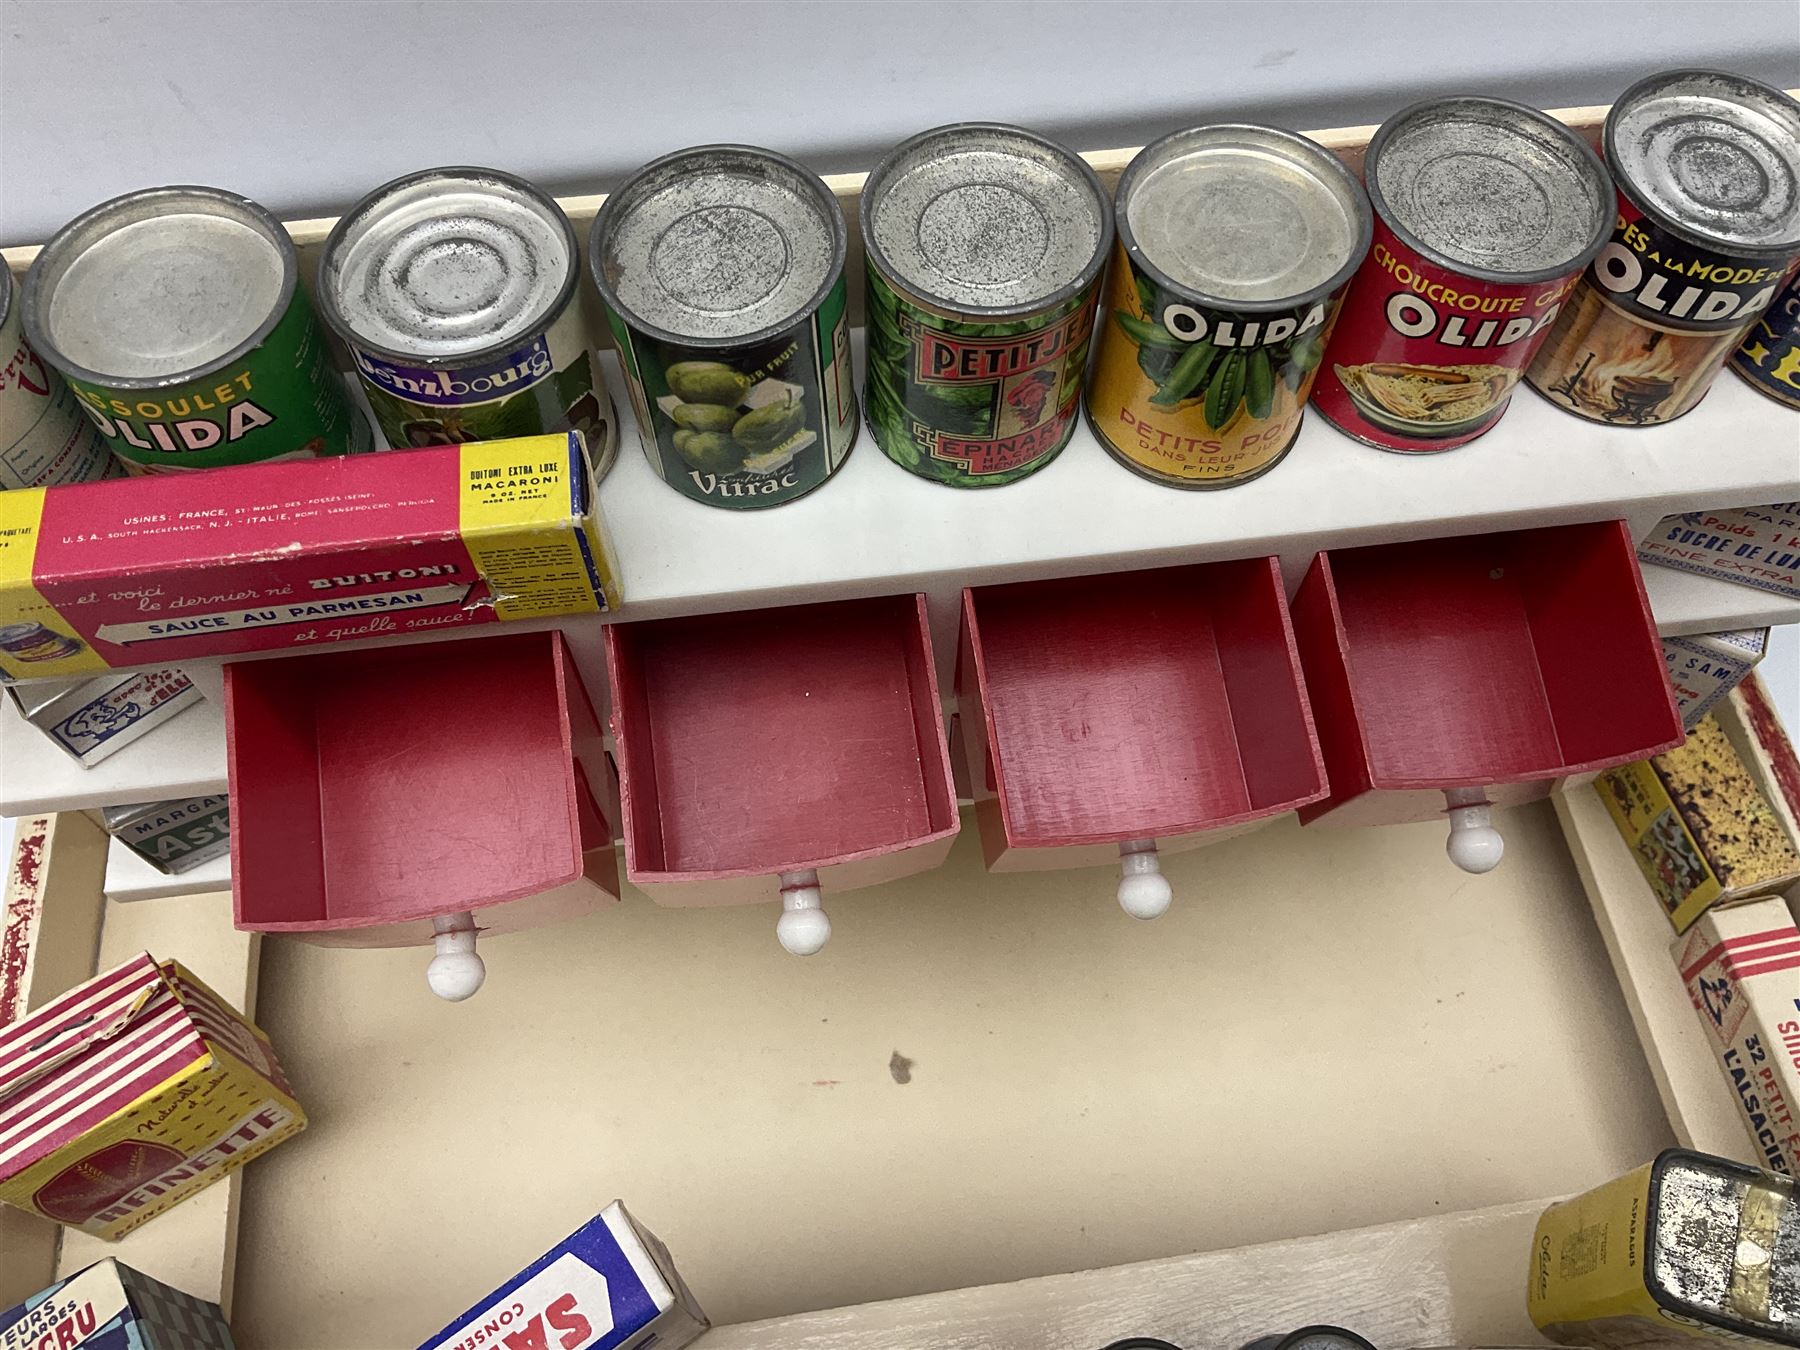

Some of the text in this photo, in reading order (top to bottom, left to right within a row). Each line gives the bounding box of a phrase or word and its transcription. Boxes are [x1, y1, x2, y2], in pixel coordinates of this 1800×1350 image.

[1373, 243, 1528, 314] CHOUCROUTE
[1594, 241, 1776, 321] OLIDA
[1687, 258, 1770, 285] MODE
[1163, 303, 1325, 348] OLIDA
[1386, 292, 1562, 347] OLIDA
[766, 341, 800, 373] FRUIT
[1119, 406, 1224, 455] PETITS
[1138, 439, 1187, 463] DANS
[1199, 451, 1246, 465] LEUR
[470, 462, 559, 480] BUITONI EXTRA LUXE
[1182, 463, 1236, 473] FINS
[471, 475, 559, 491] MACARONI
[107, 530, 138, 539] SOUTH
[246, 513, 292, 526] ITALIE,
[178, 508, 229, 520] FRANCE,
[1744, 510, 1800, 531] PAR
[1666, 526, 1734, 552] SUCRE
[1733, 542, 1763, 560] DE
[1703, 515, 1757, 538] Poids
[1772, 532, 1783, 543] 1
[1713, 557, 1794, 585] EXTRA
[107, 584, 166, 601] voici
[136, 564, 461, 612] le dernier né BUITONI
[148, 592, 425, 635] SAUCE AU PARMESAN
[294, 628, 319, 642] et
[325, 616, 397, 641] quelle
[1685, 657, 1731, 680] SAM
[1744, 1033, 1767, 1066] 32
[1628, 1197, 1640, 1268] ASPARAGUS
[20, 1299, 77, 1348] LARGES
